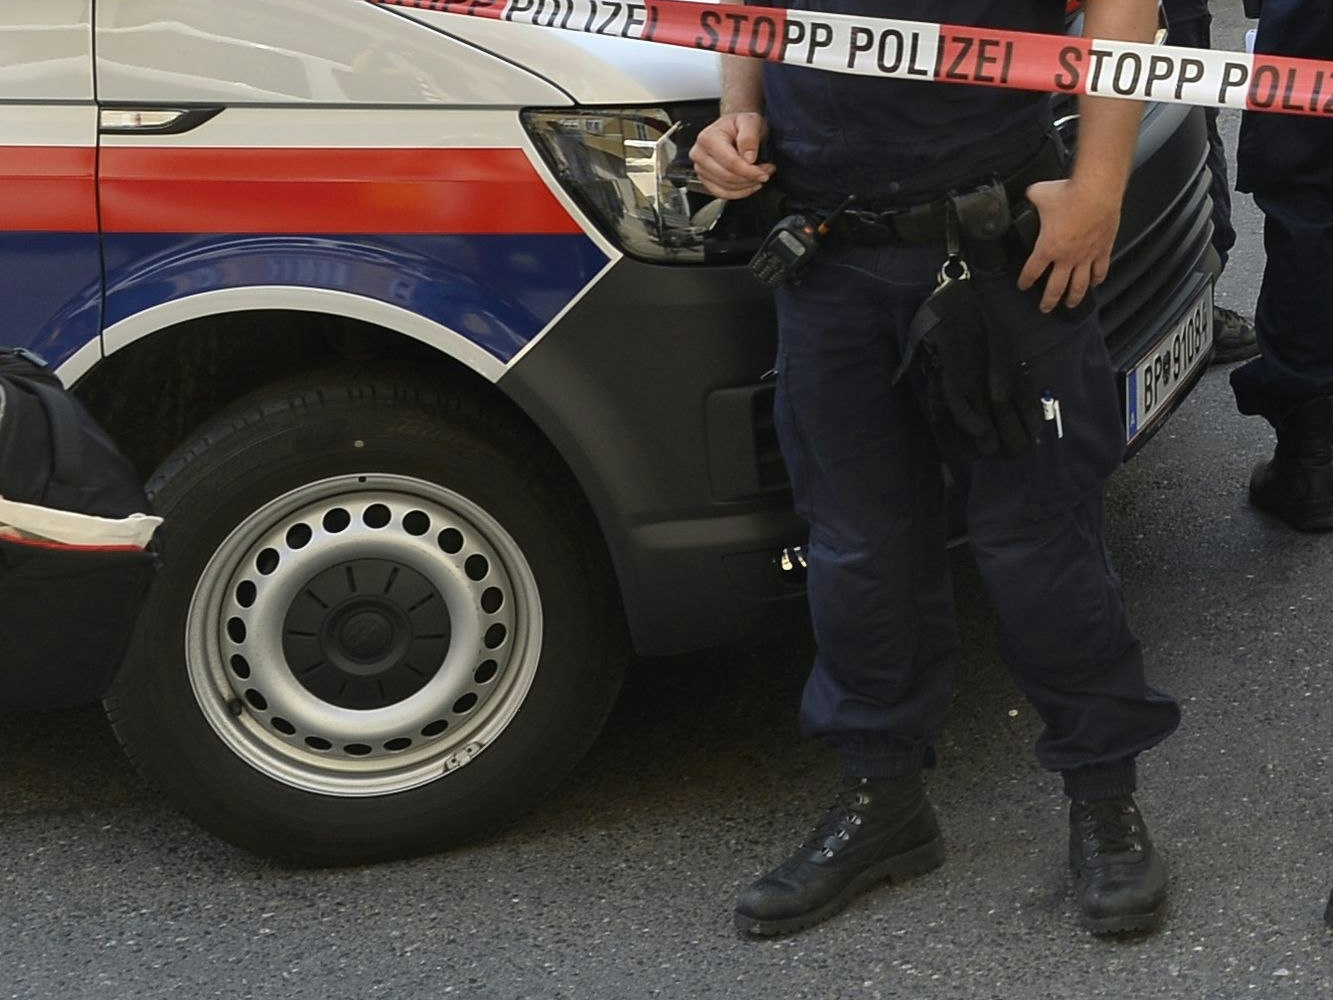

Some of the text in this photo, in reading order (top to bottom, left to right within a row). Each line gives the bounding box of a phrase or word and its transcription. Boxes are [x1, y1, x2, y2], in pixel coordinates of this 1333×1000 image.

[695, 10, 833, 64] STOPP
[847, 26, 1014, 84] POLIZEI
[1054, 46, 1205, 99] STOPP
[1144, 354, 1162, 415] BP
